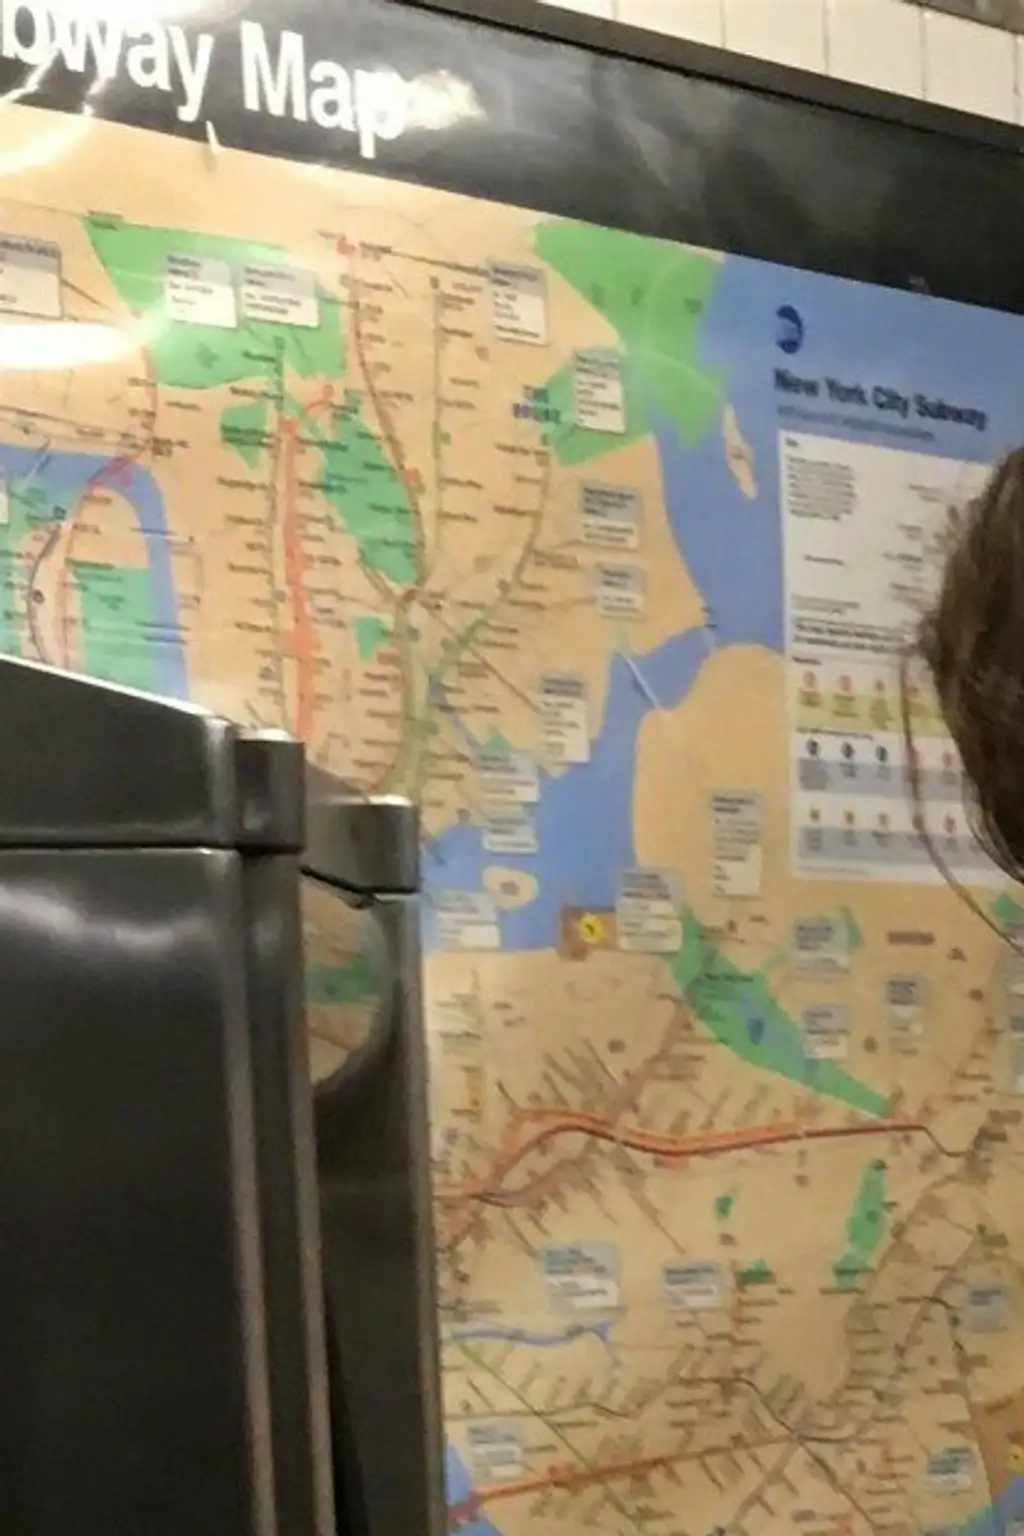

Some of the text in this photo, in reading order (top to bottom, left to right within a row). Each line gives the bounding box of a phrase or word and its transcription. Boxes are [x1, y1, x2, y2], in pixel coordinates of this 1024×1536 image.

[240, 20, 405, 159] Map
[775, 368, 819, 398] New
[824, 377, 869, 406] York
[872, 385, 910, 419] City
[913, 394, 987, 432] Subway
